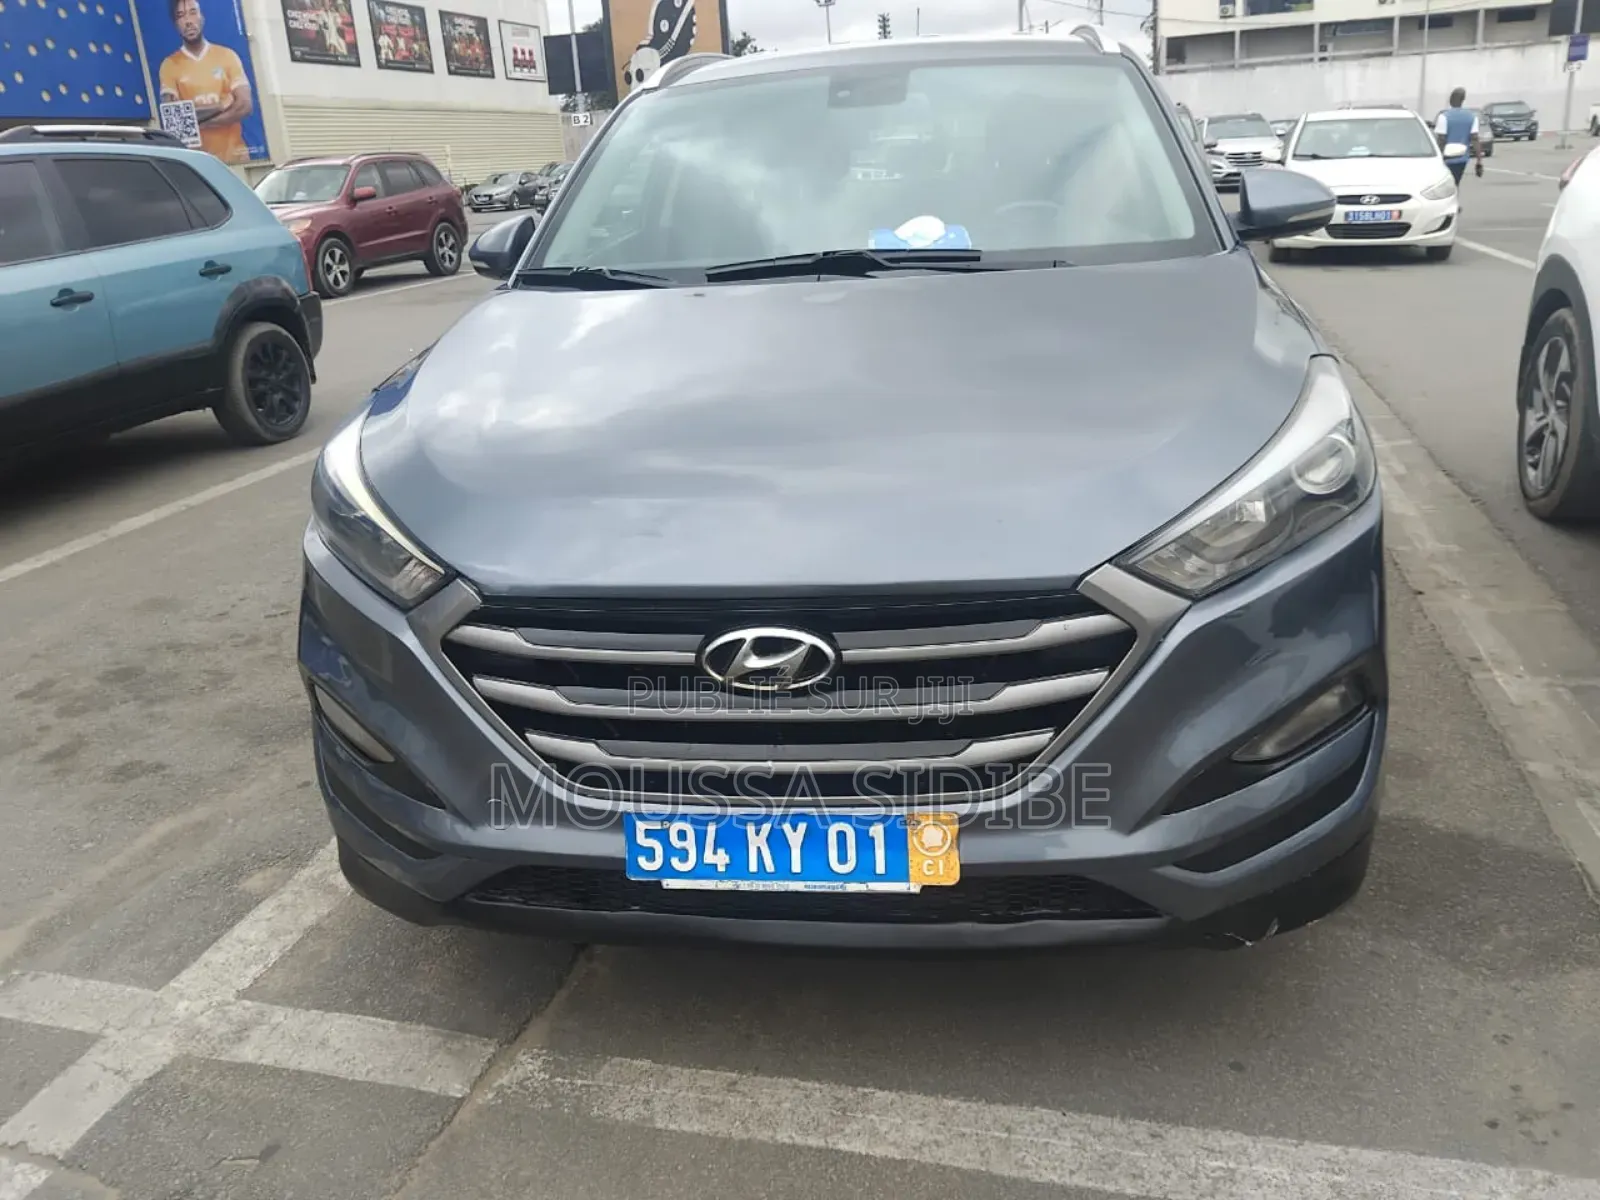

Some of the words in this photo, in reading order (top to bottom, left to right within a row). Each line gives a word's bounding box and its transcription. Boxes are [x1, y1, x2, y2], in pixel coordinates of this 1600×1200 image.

[573, 115, 581, 125] B
[583, 114, 590, 124] 2
[636, 821, 730, 873] 594
[747, 822, 808, 874] KY
[828, 822, 887, 875] 01
[922, 859, 945, 876] CI
